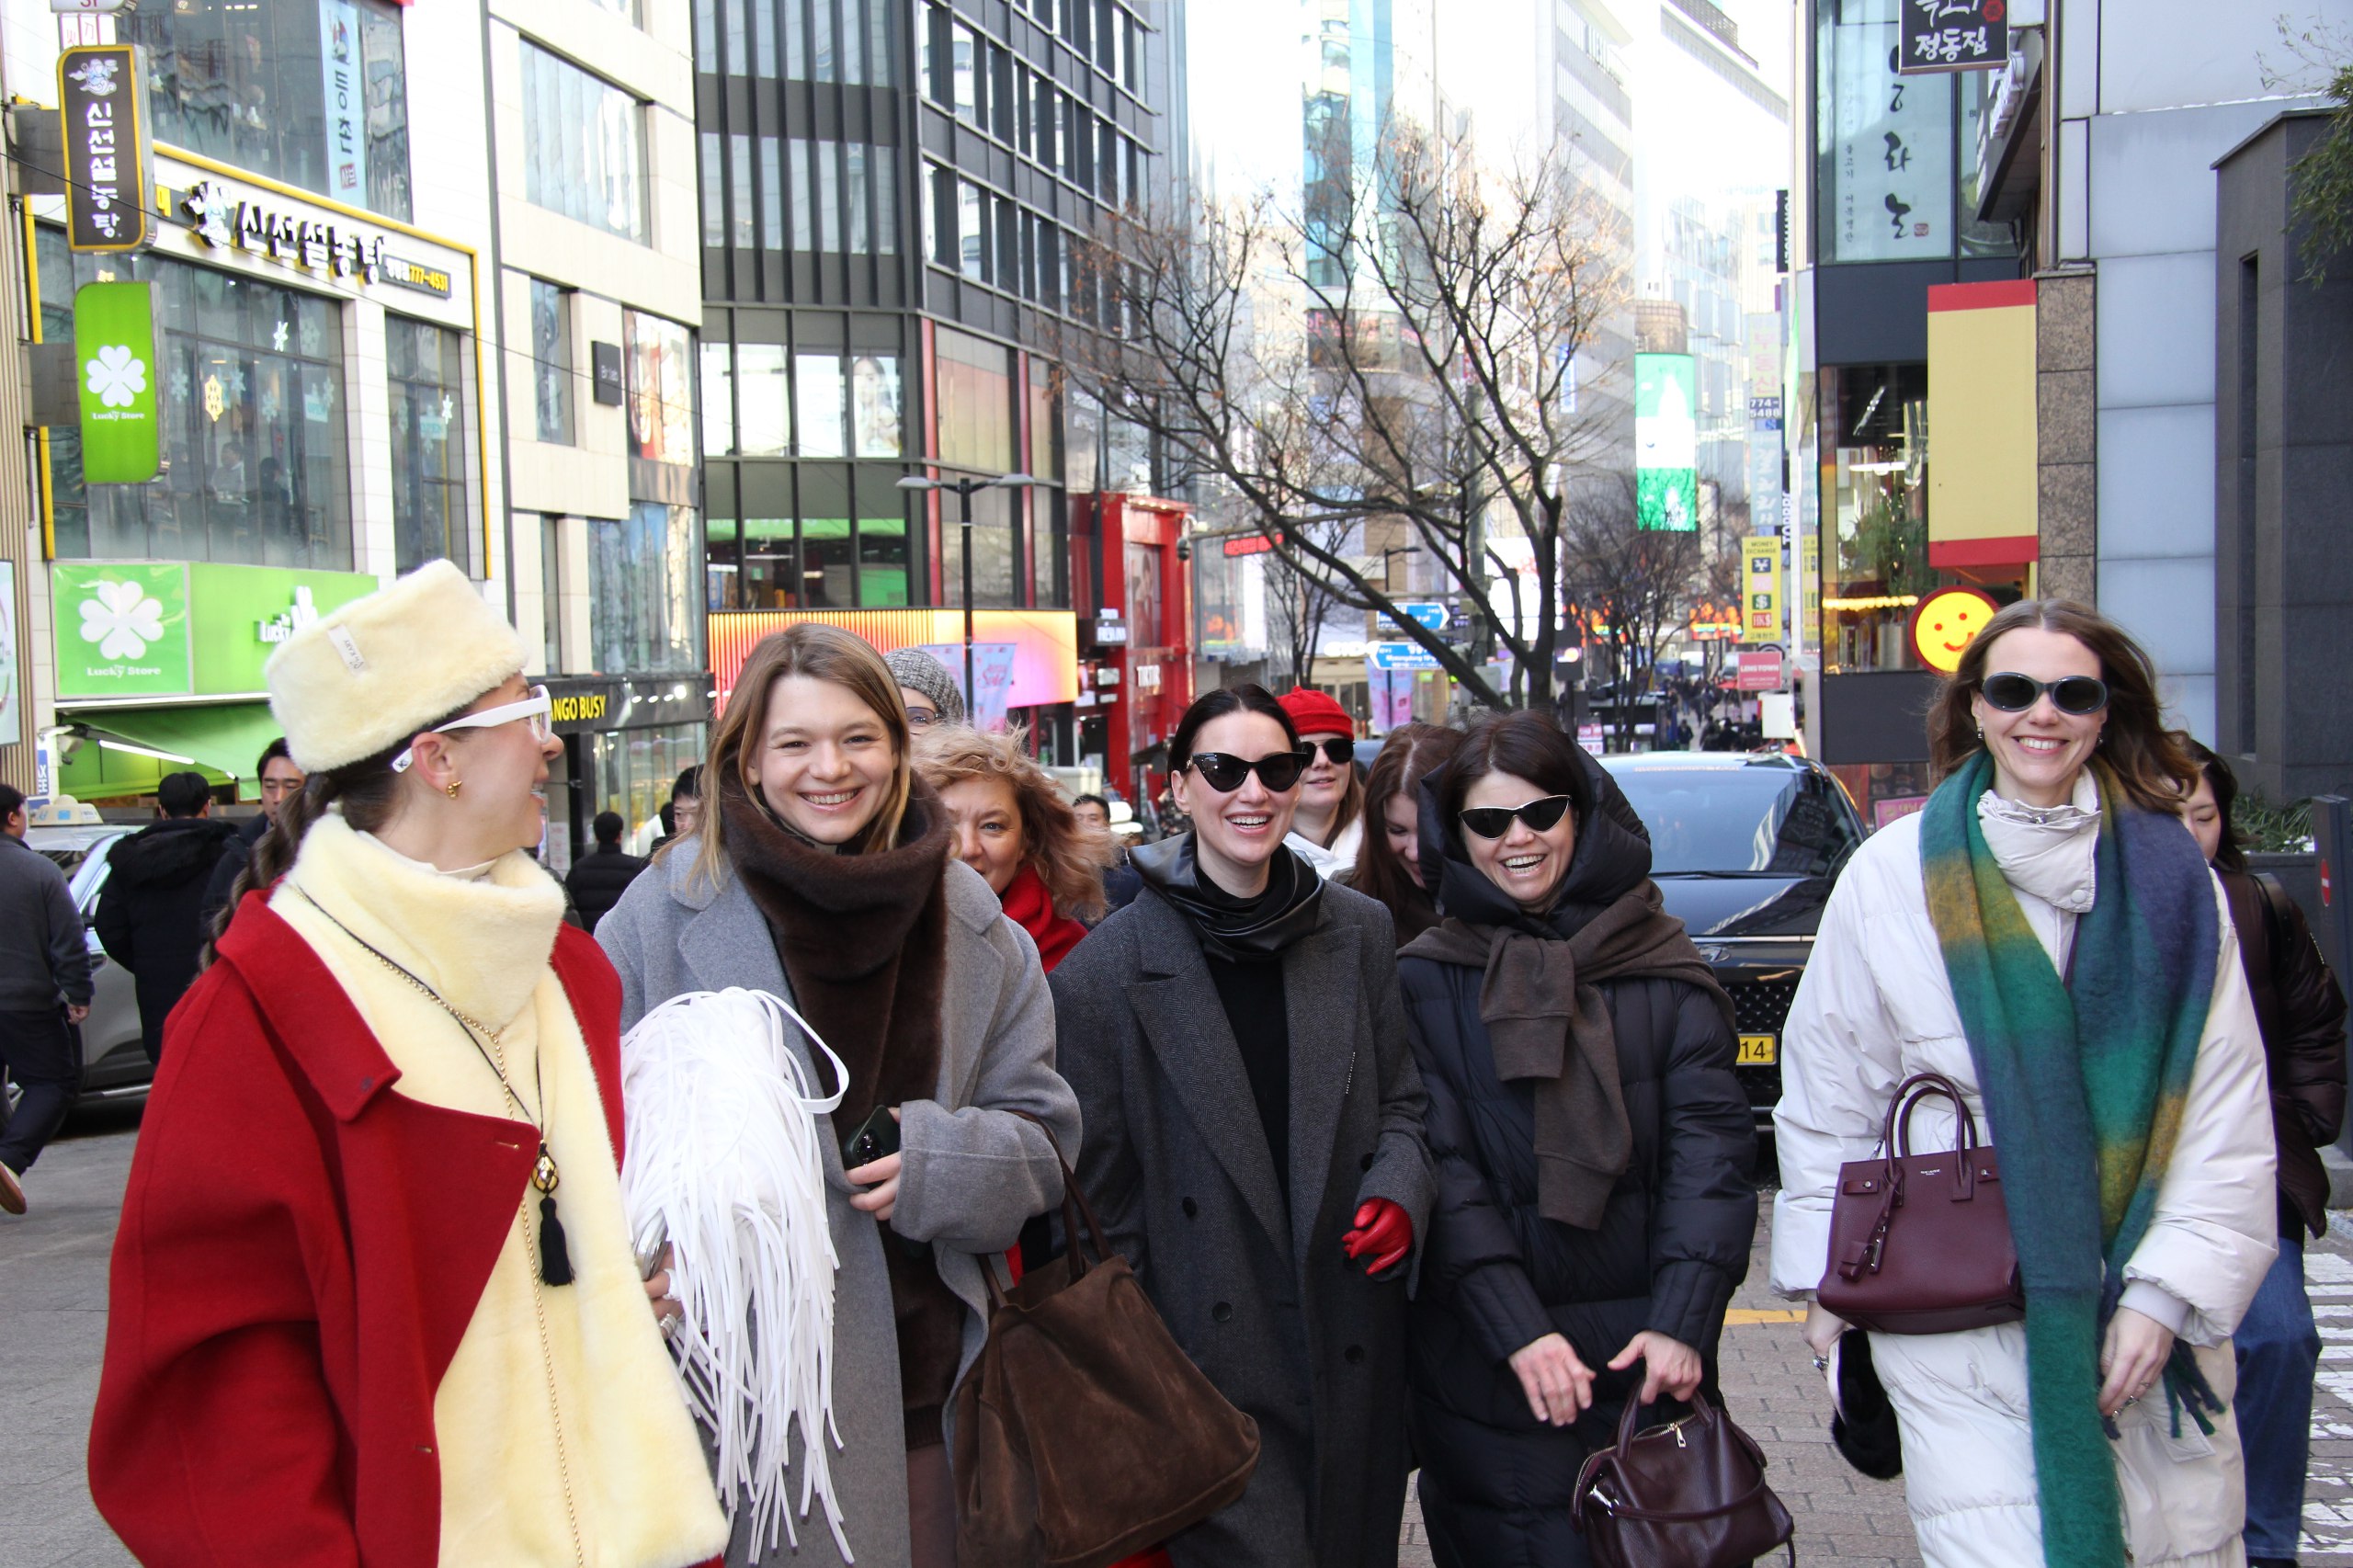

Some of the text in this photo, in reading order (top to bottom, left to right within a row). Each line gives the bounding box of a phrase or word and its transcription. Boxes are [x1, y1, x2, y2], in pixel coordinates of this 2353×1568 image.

[1915, 26, 1987, 62] 정동집
[87, 102, 120, 238] 신선설농탕
[237, 201, 384, 285] 신선설농탕
[1754, 332, 1779, 393] 부동산
[92, 412, 145, 422] Lucky Store
[85, 666, 162, 678] Lucky Store
[579, 694, 606, 720] BUSY
[1741, 1040, 1766, 1059] 14
